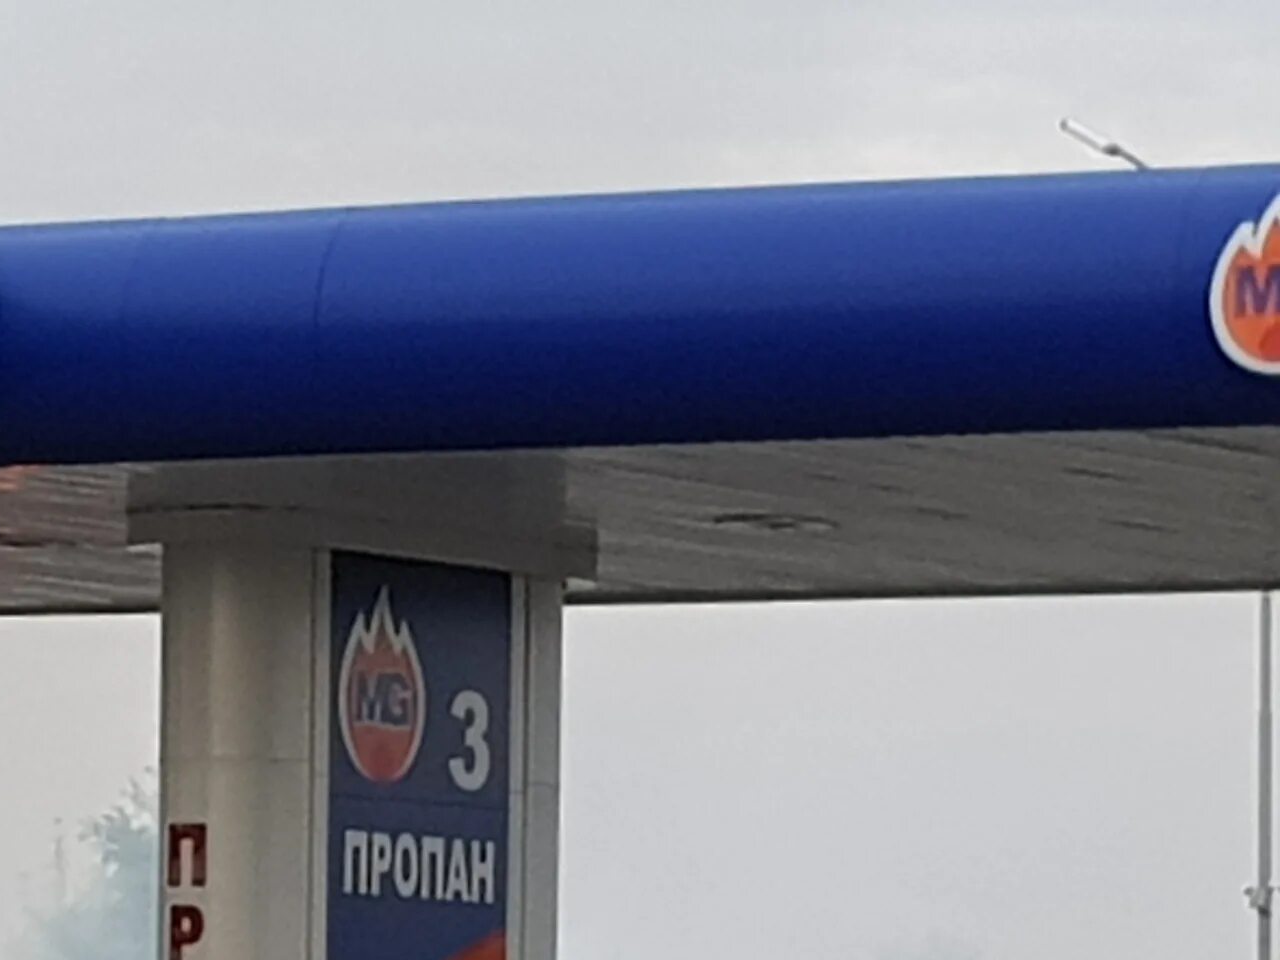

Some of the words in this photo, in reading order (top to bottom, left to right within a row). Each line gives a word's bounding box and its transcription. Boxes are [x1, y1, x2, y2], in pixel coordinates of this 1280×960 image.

[356, 671, 410, 727] MG
[448, 689, 490, 791] 3
[343, 829, 494, 904] ПРОПАН
